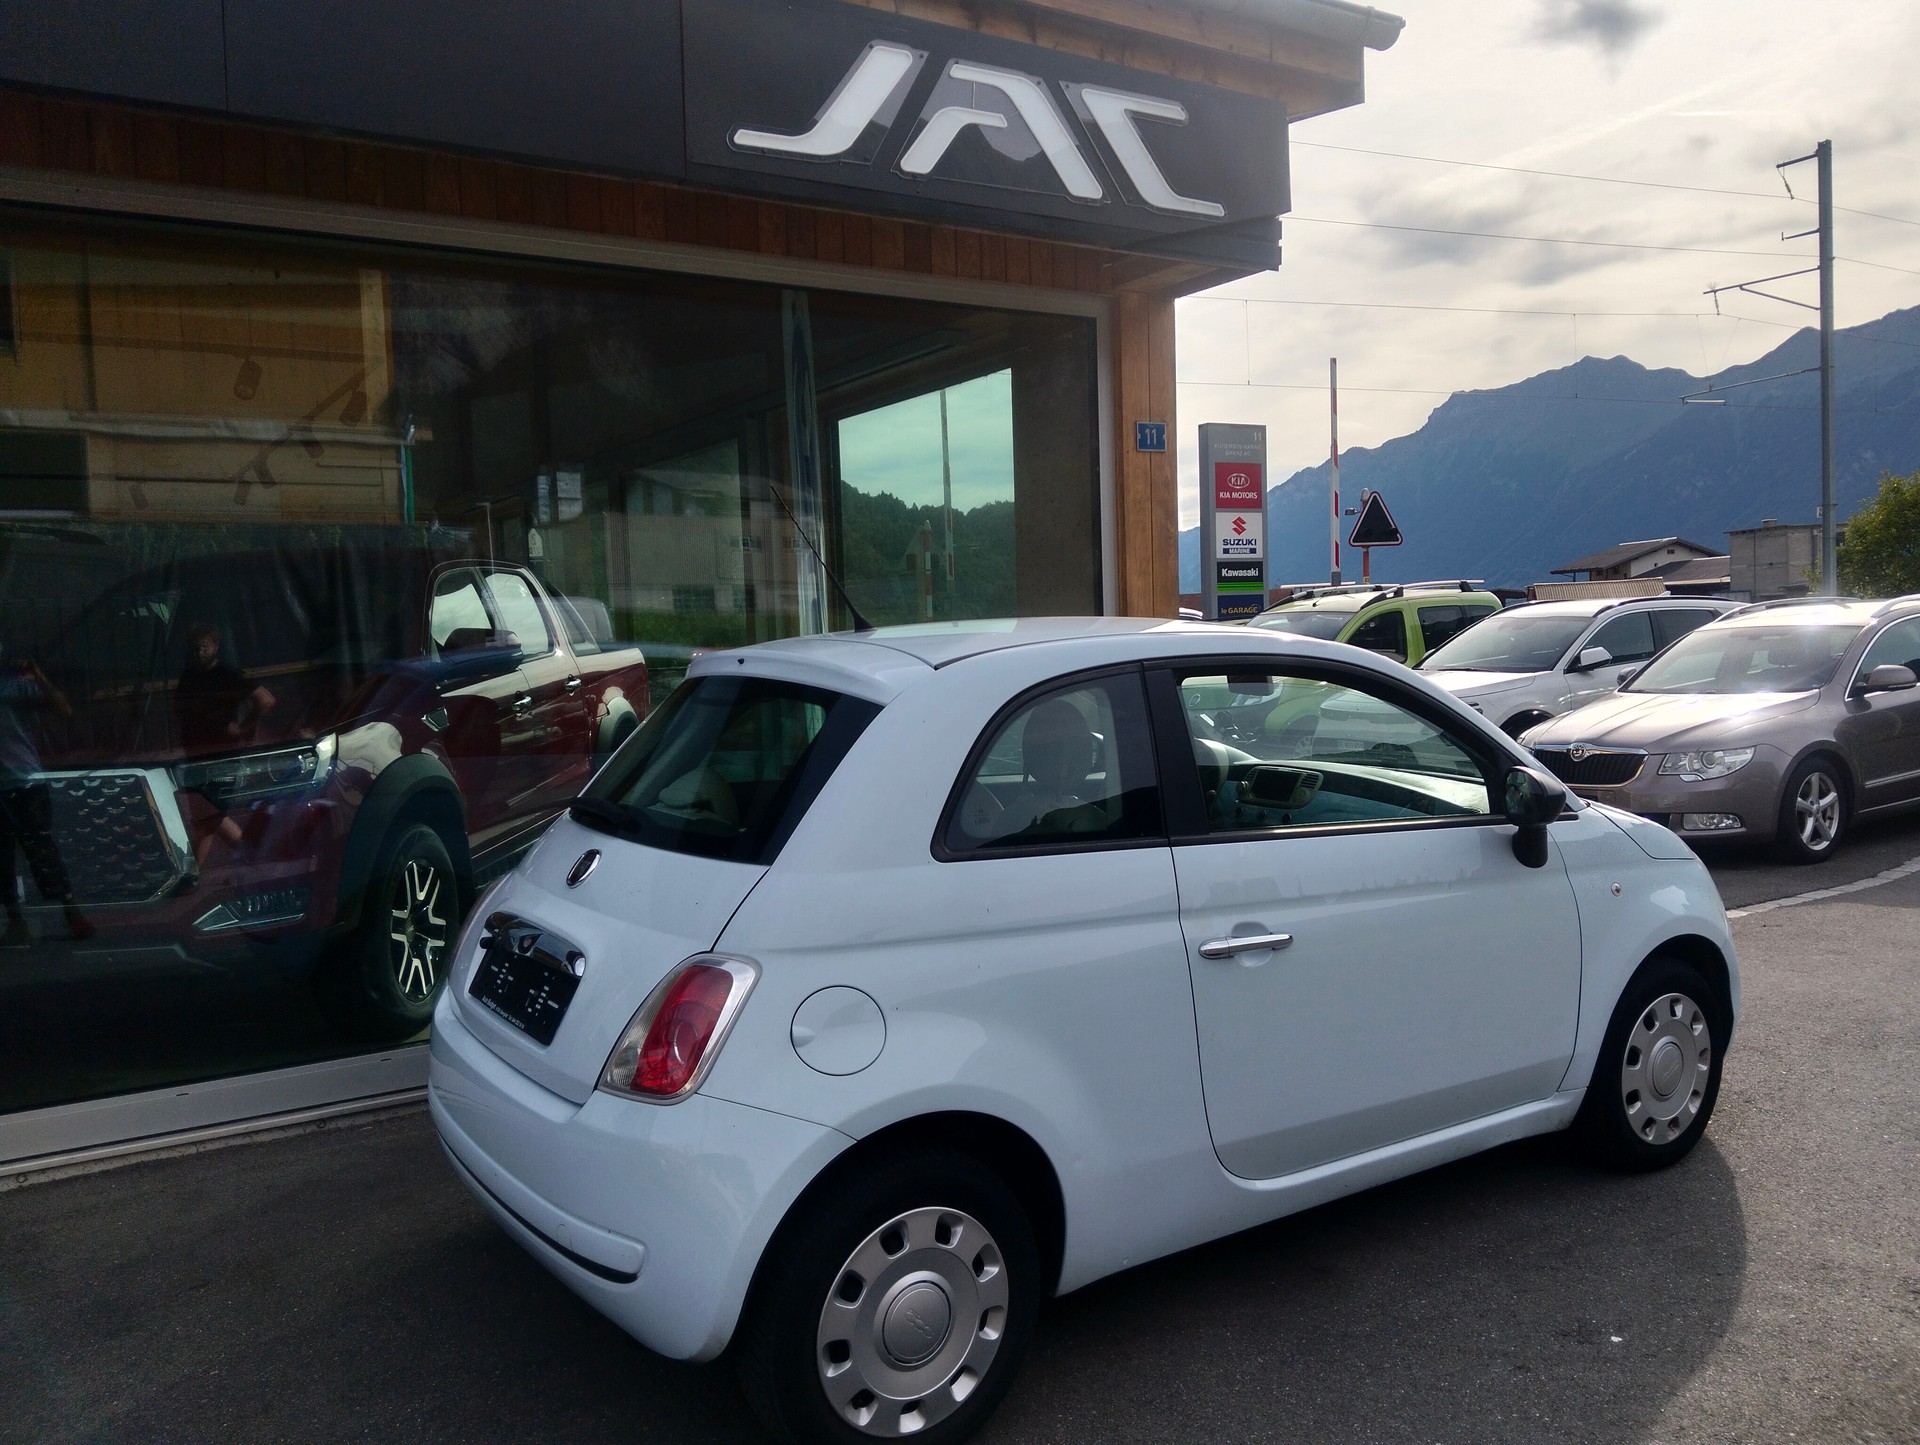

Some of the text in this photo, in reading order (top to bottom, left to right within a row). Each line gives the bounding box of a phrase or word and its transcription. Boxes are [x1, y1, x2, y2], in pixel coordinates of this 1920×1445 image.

[733, 45, 1226, 218] JAC
[1144, 428, 1157, 445] 11
[1253, 431, 1262, 442] 11
[1231, 477, 1247, 486] KIA
[1220, 491, 1258, 499] KIA MOTORS
[1222, 538, 1257, 546] SUZUKI
[1221, 568, 1259, 577] Kawasaki
[1228, 606, 1258, 614] GARAGE
